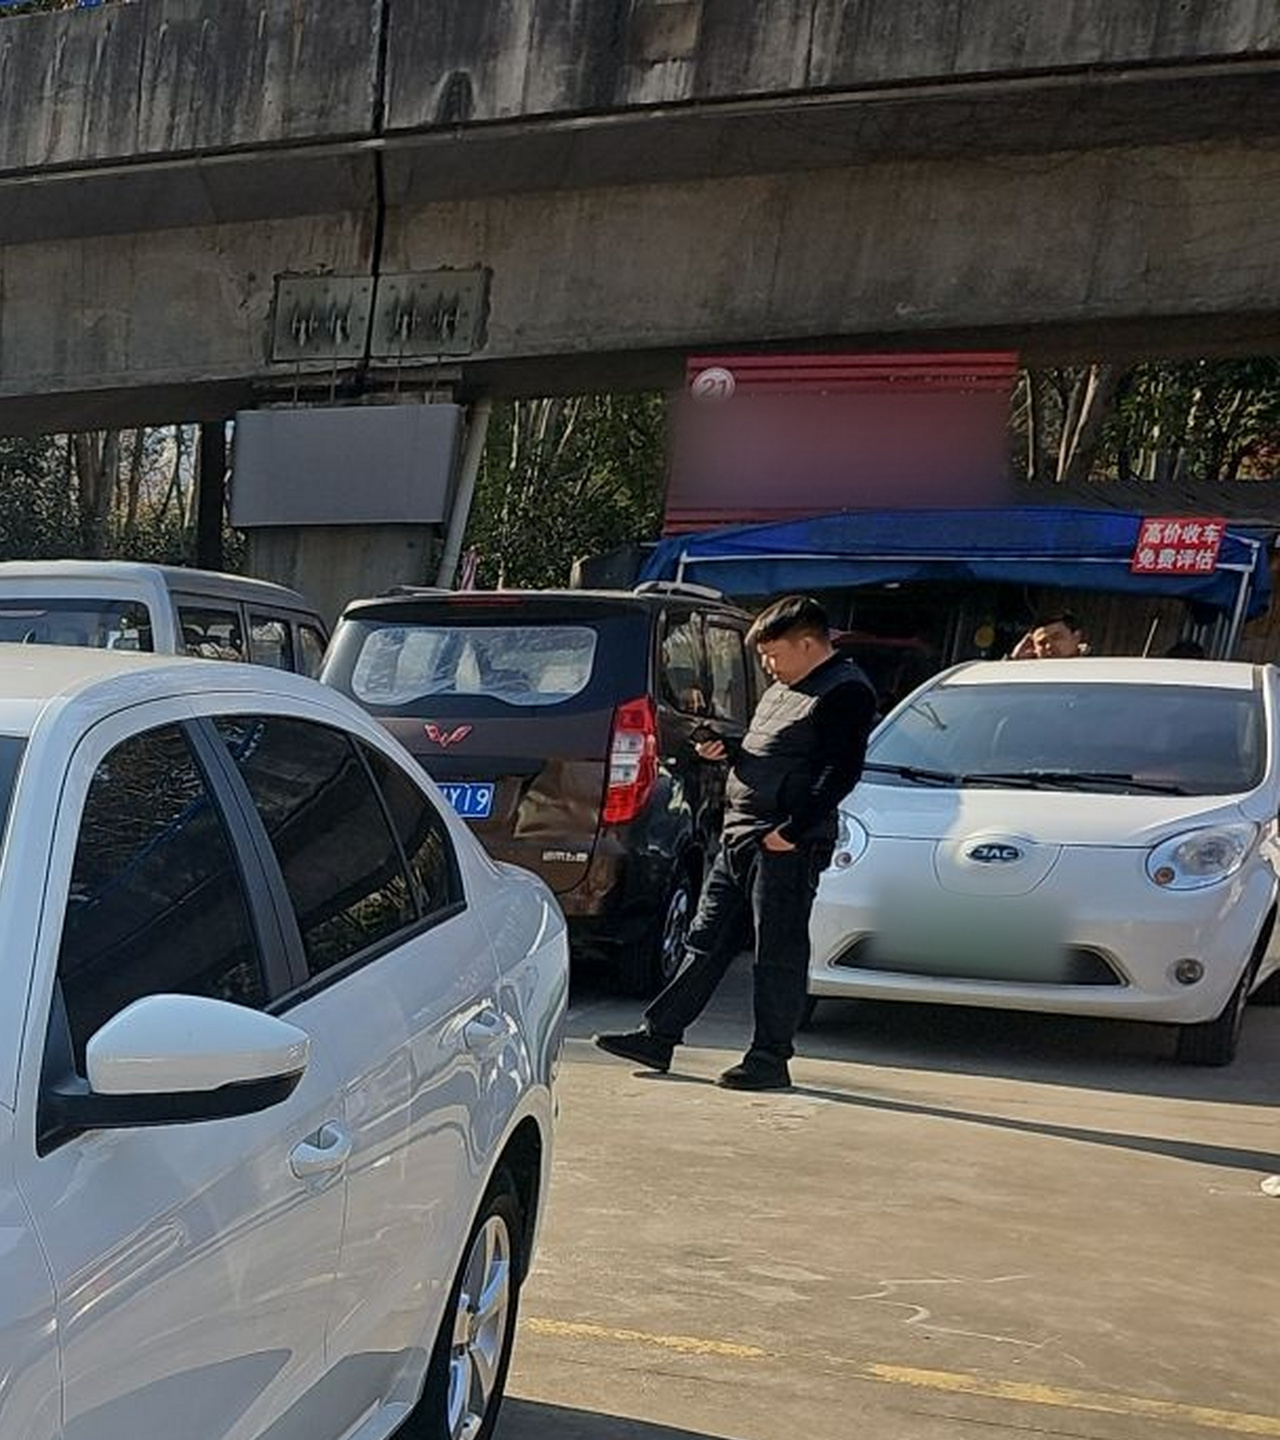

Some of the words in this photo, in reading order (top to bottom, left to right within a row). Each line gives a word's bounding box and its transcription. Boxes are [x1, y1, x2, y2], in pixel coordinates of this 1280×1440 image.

[1143, 523, 1221, 544] 高价收车
[1136, 548, 1214, 570] 免费评估
[443, 788, 490, 811] Y19
